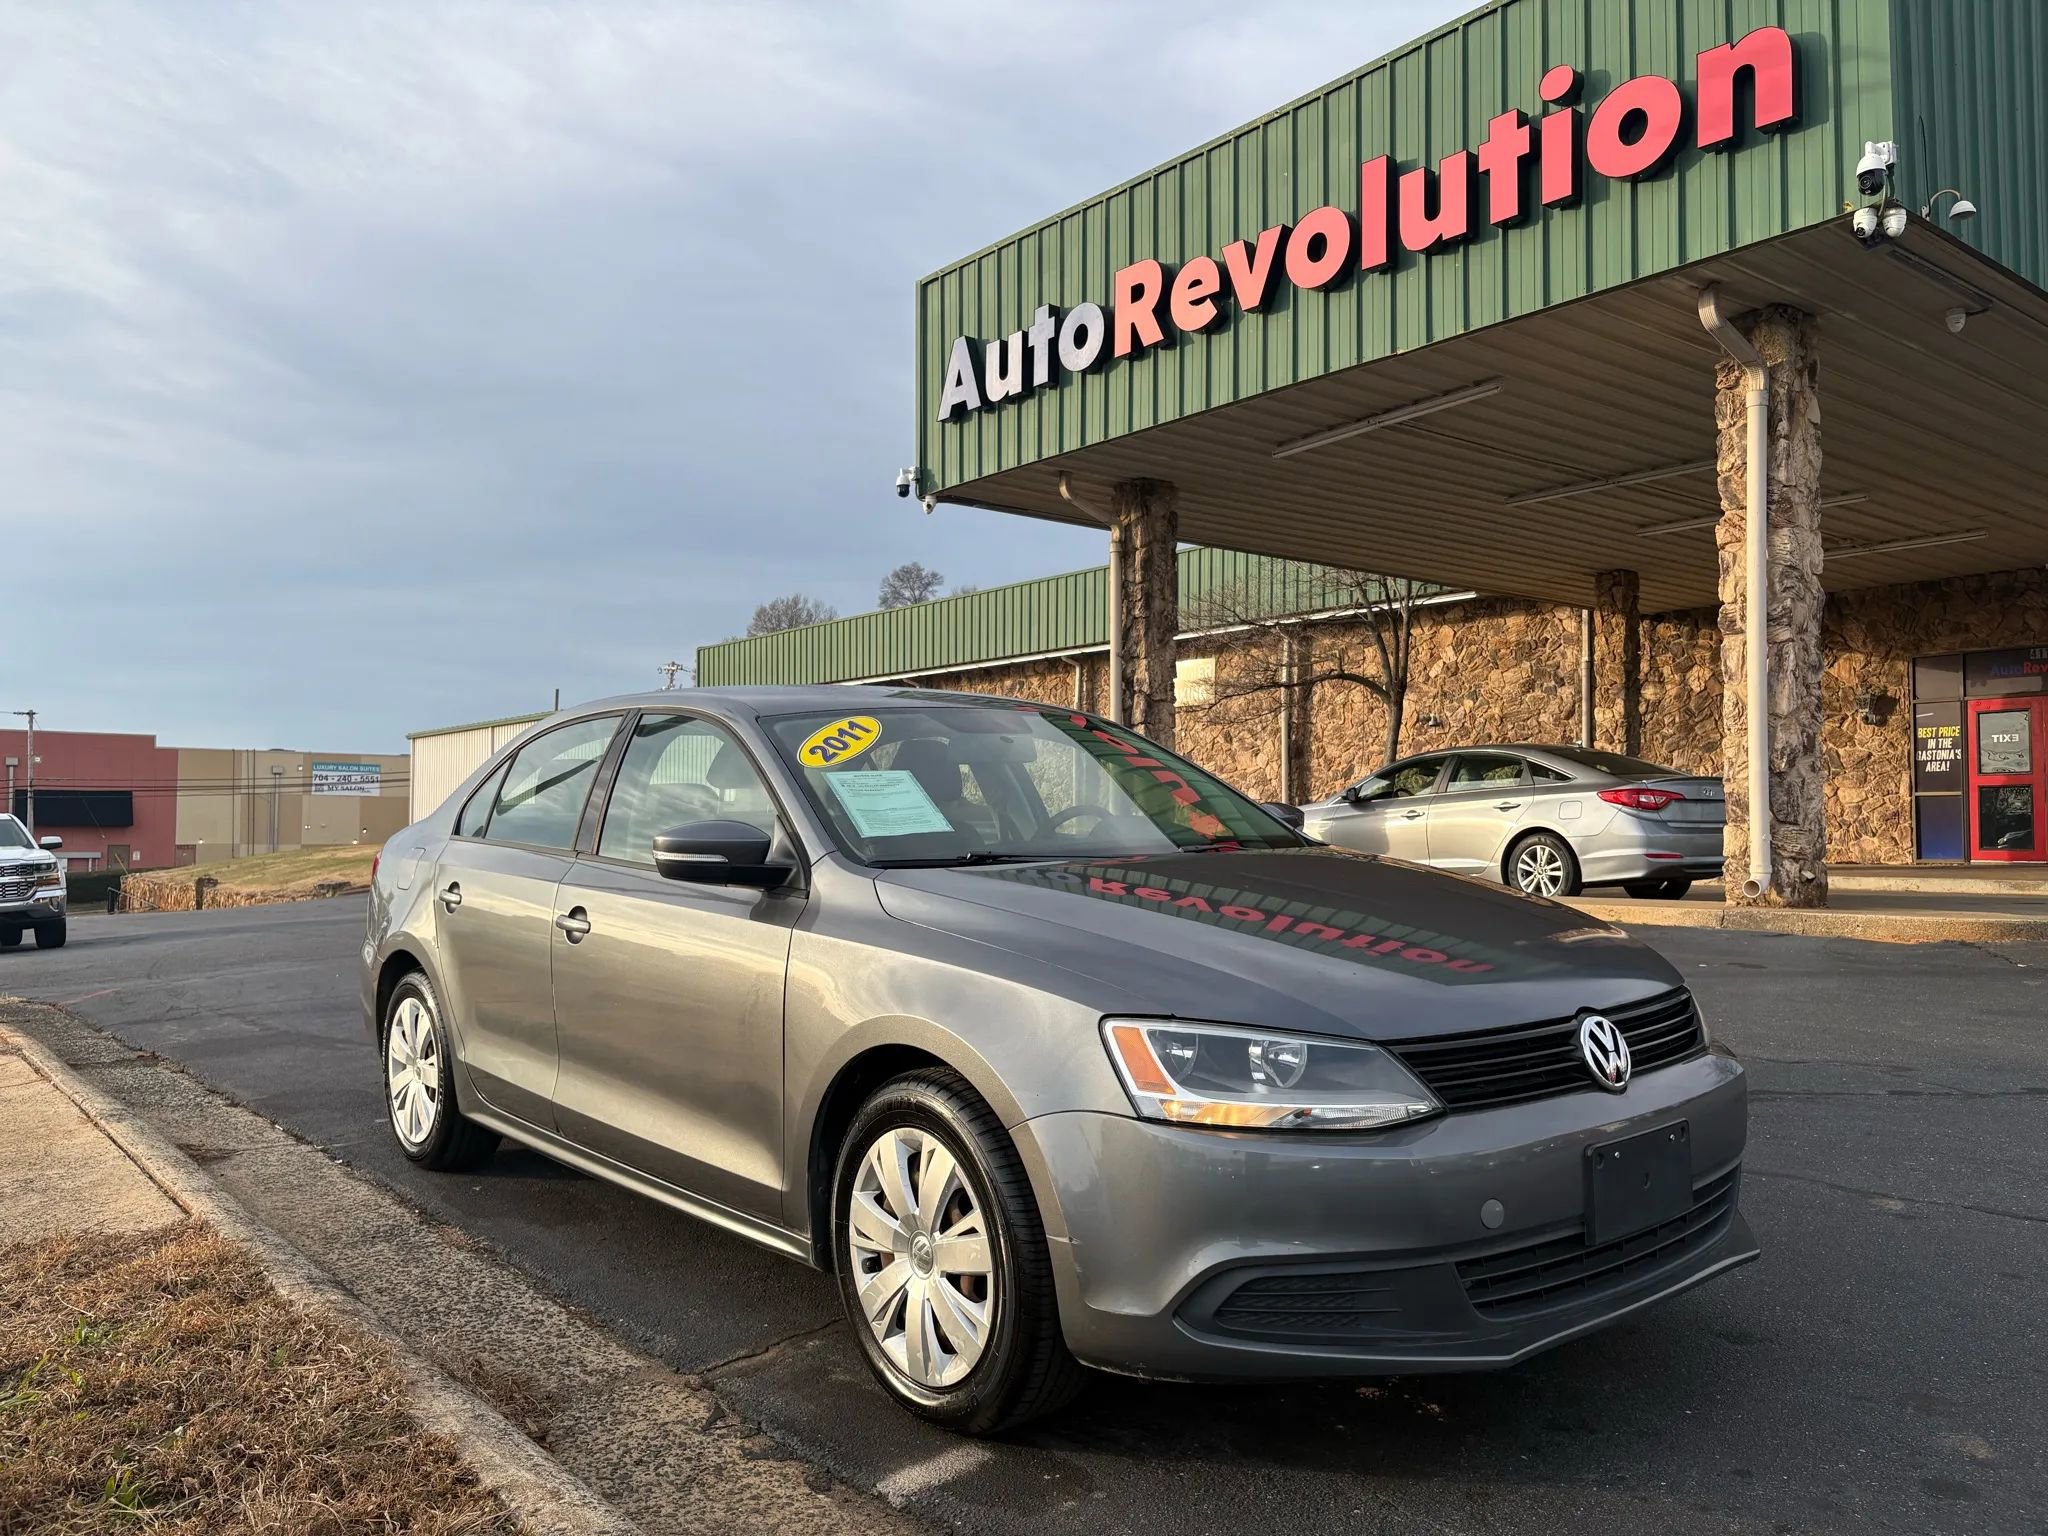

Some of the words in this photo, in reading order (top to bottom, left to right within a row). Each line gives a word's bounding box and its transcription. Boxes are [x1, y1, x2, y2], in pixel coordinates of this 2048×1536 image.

[1917, 727, 1937, 738] BEST
[1938, 726, 1960, 737] PRICE
[808, 720, 873, 763] 2011
[1927, 738, 1936, 749] IN
[1938, 737, 1953, 748] THE
[1925, 760, 1950, 772] AREA!
